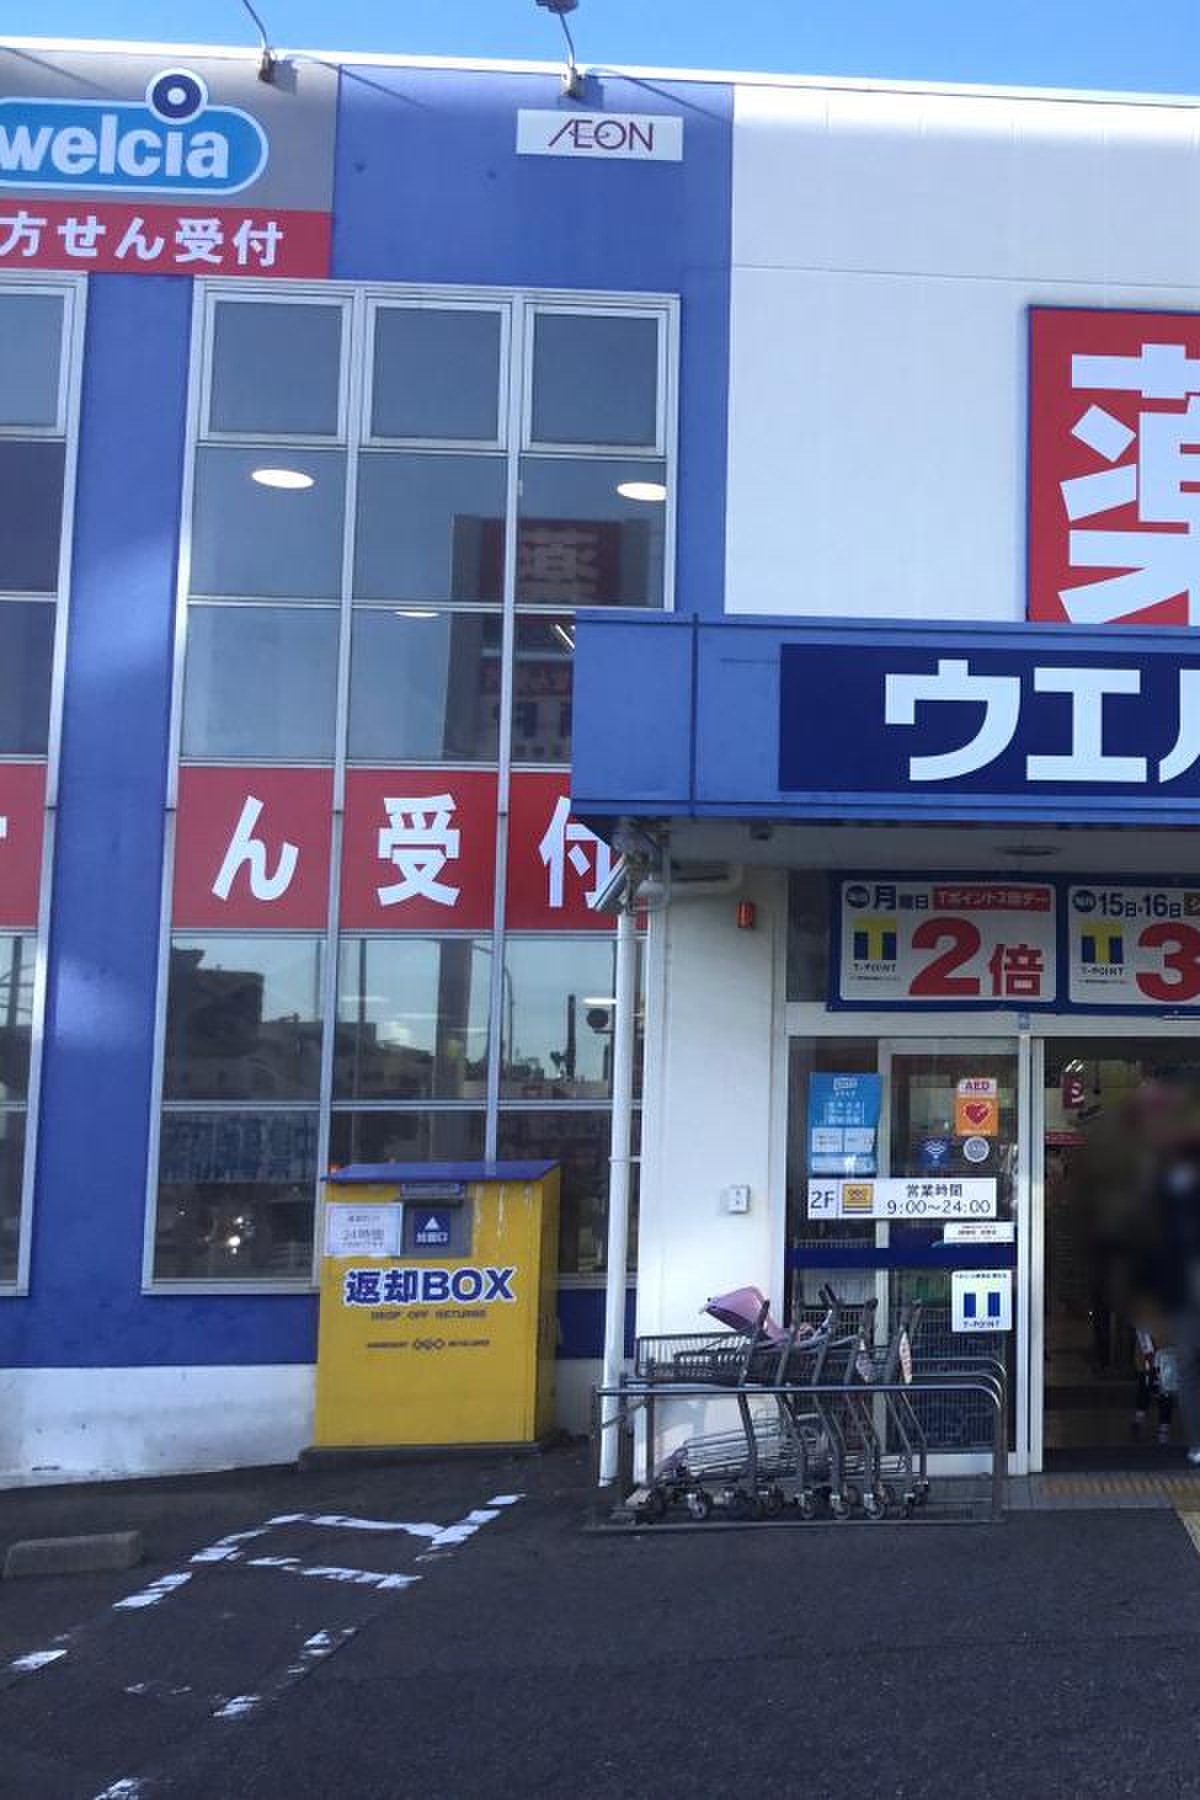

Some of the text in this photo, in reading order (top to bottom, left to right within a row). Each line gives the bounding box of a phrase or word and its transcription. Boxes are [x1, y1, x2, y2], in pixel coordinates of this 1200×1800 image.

[0, 114, 229, 178] welcia
[0, 211, 284, 266] 方せん受付
[965, 1080, 990, 1090] AED
[810, 1190, 835, 1210] 2F
[906, 1183, 963, 1198] 営業時間
[345, 1268, 515, 1305] 返却BOX
